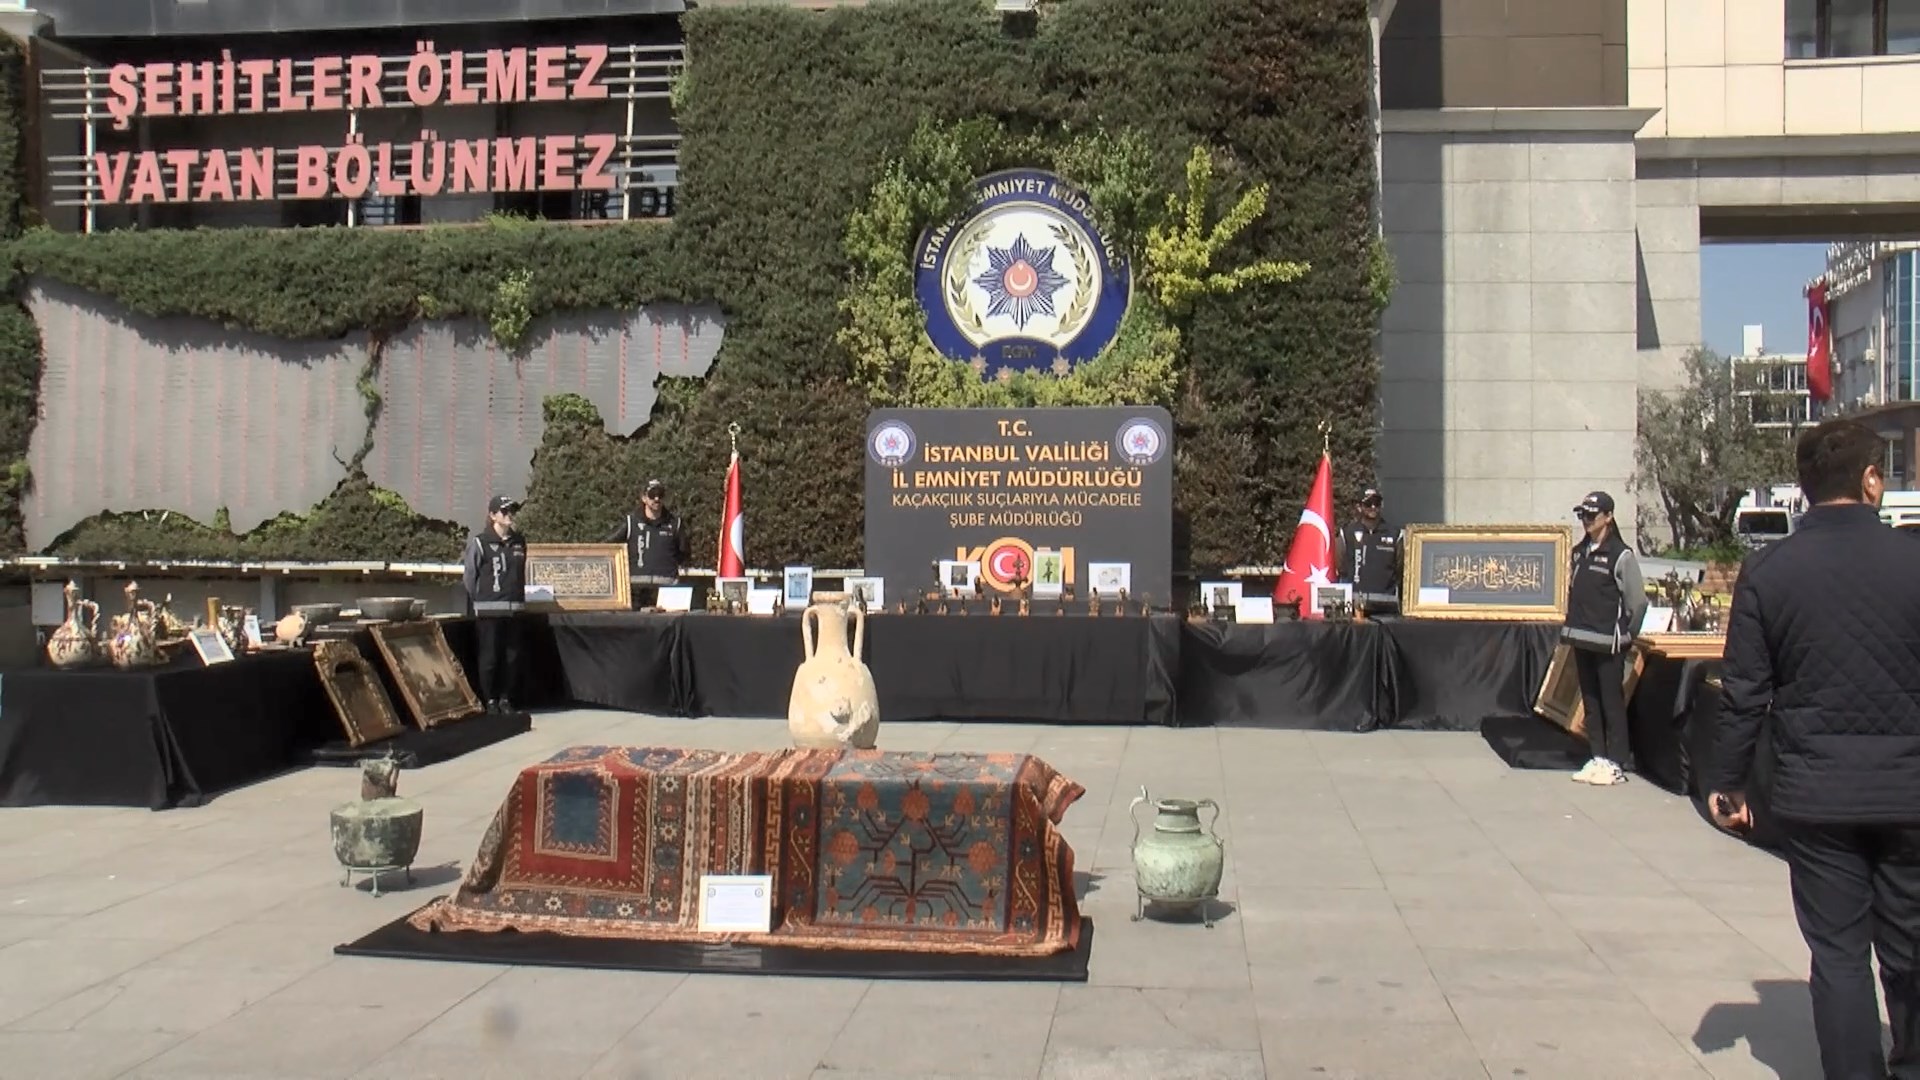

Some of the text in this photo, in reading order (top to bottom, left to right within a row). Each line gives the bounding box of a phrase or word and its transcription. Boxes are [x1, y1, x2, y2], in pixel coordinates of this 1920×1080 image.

[105, 41, 609, 131] ŞEHİTLER ÖLMEZ
[94, 130, 618, 204] VATAN BÖLÜNMEZ
[997, 419, 1033, 437] T.C.
[924, 440, 1109, 463] İSTANBUL VALİLİĞİ
[892, 466, 1143, 489] İL EMNİYET MÜDÜRLÜĞÜ
[892, 490, 1142, 509] KAÇAKÇILIK SUÇLARIYLA MÜCADELE
[950, 510, 1082, 528] ŞUBE MÜDÜRLÜĞÜ
